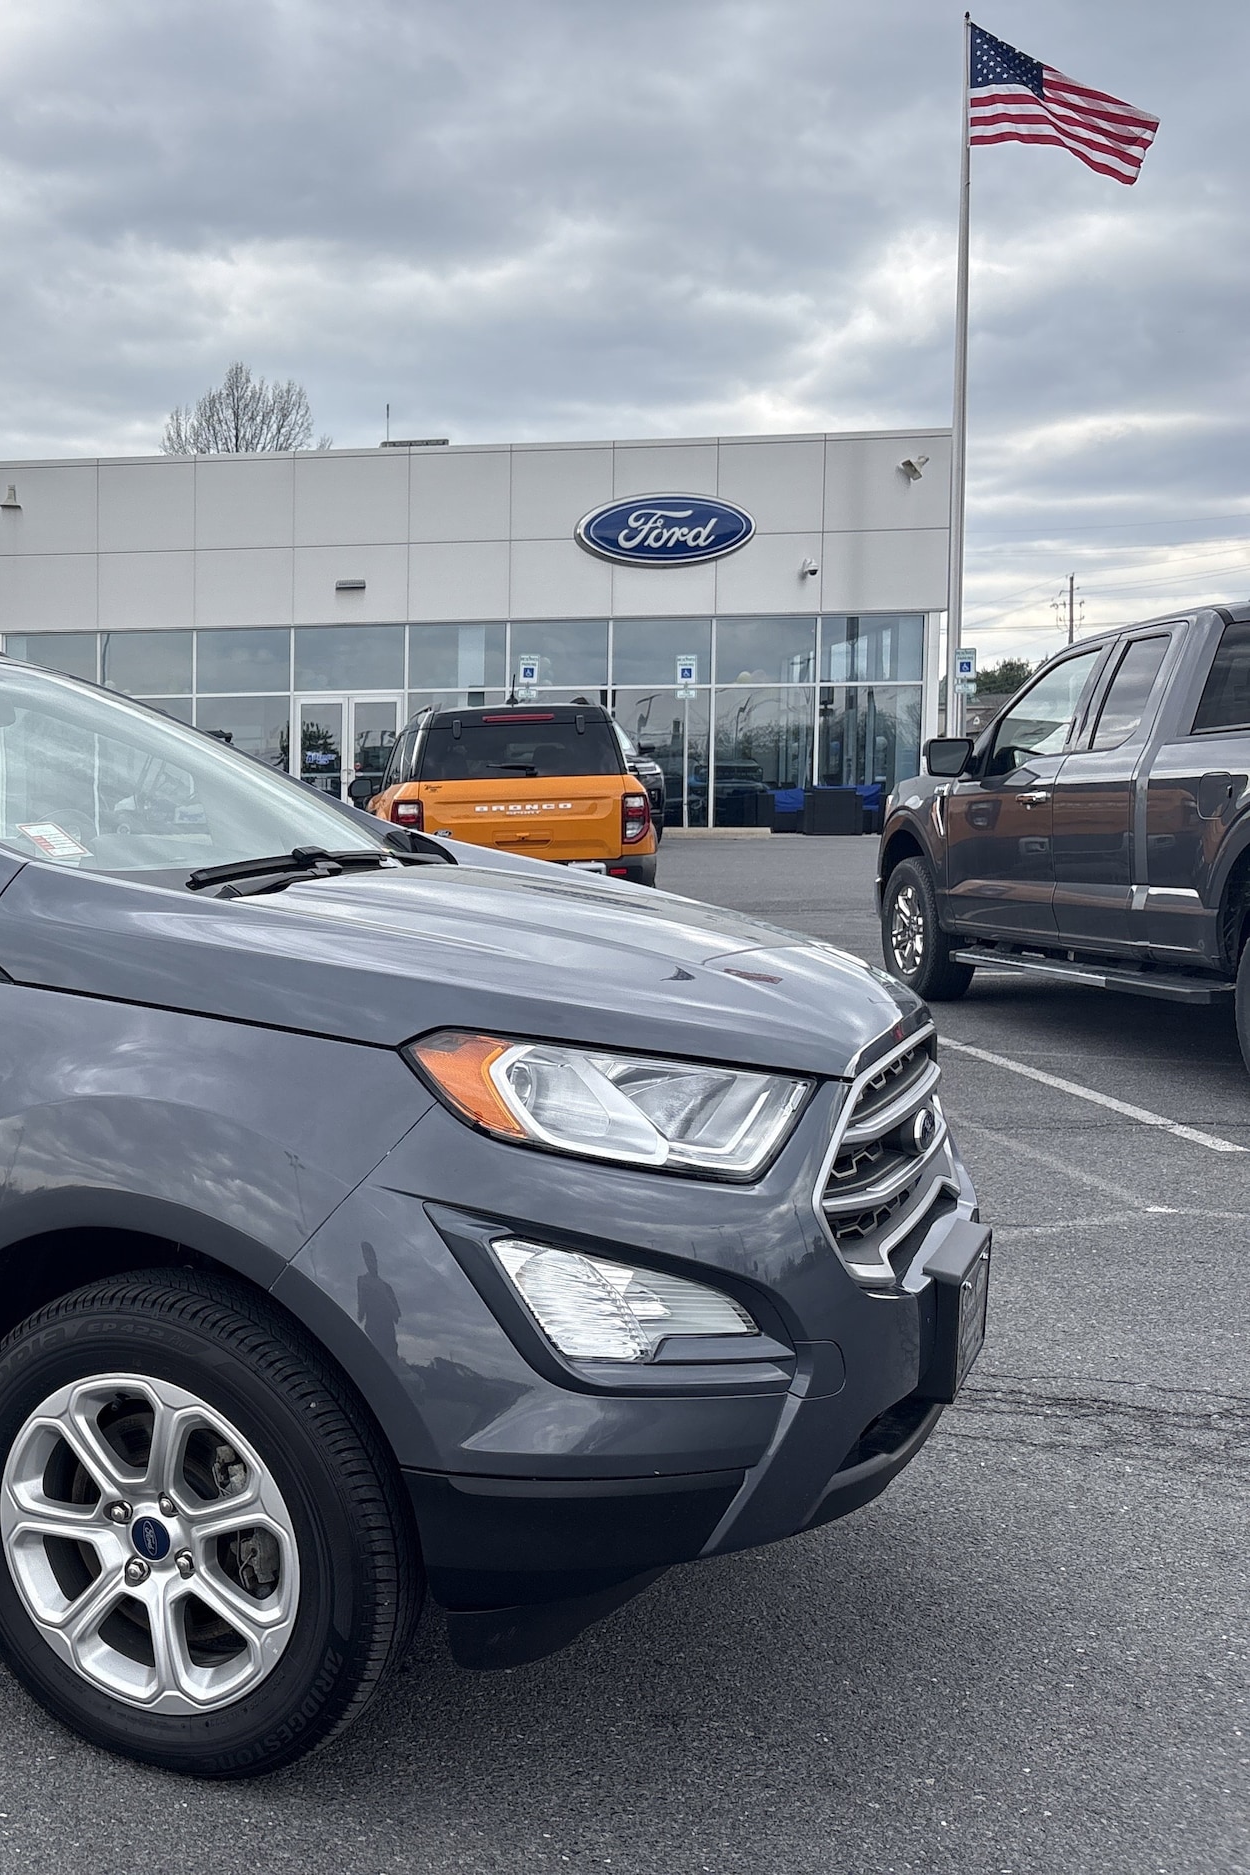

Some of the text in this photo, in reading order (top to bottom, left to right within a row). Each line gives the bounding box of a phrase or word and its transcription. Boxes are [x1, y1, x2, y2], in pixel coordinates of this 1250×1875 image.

[617, 509, 718, 549] Ford
[475, 802, 572, 812] BRONCO
[120, 1322, 164, 1339] 422
